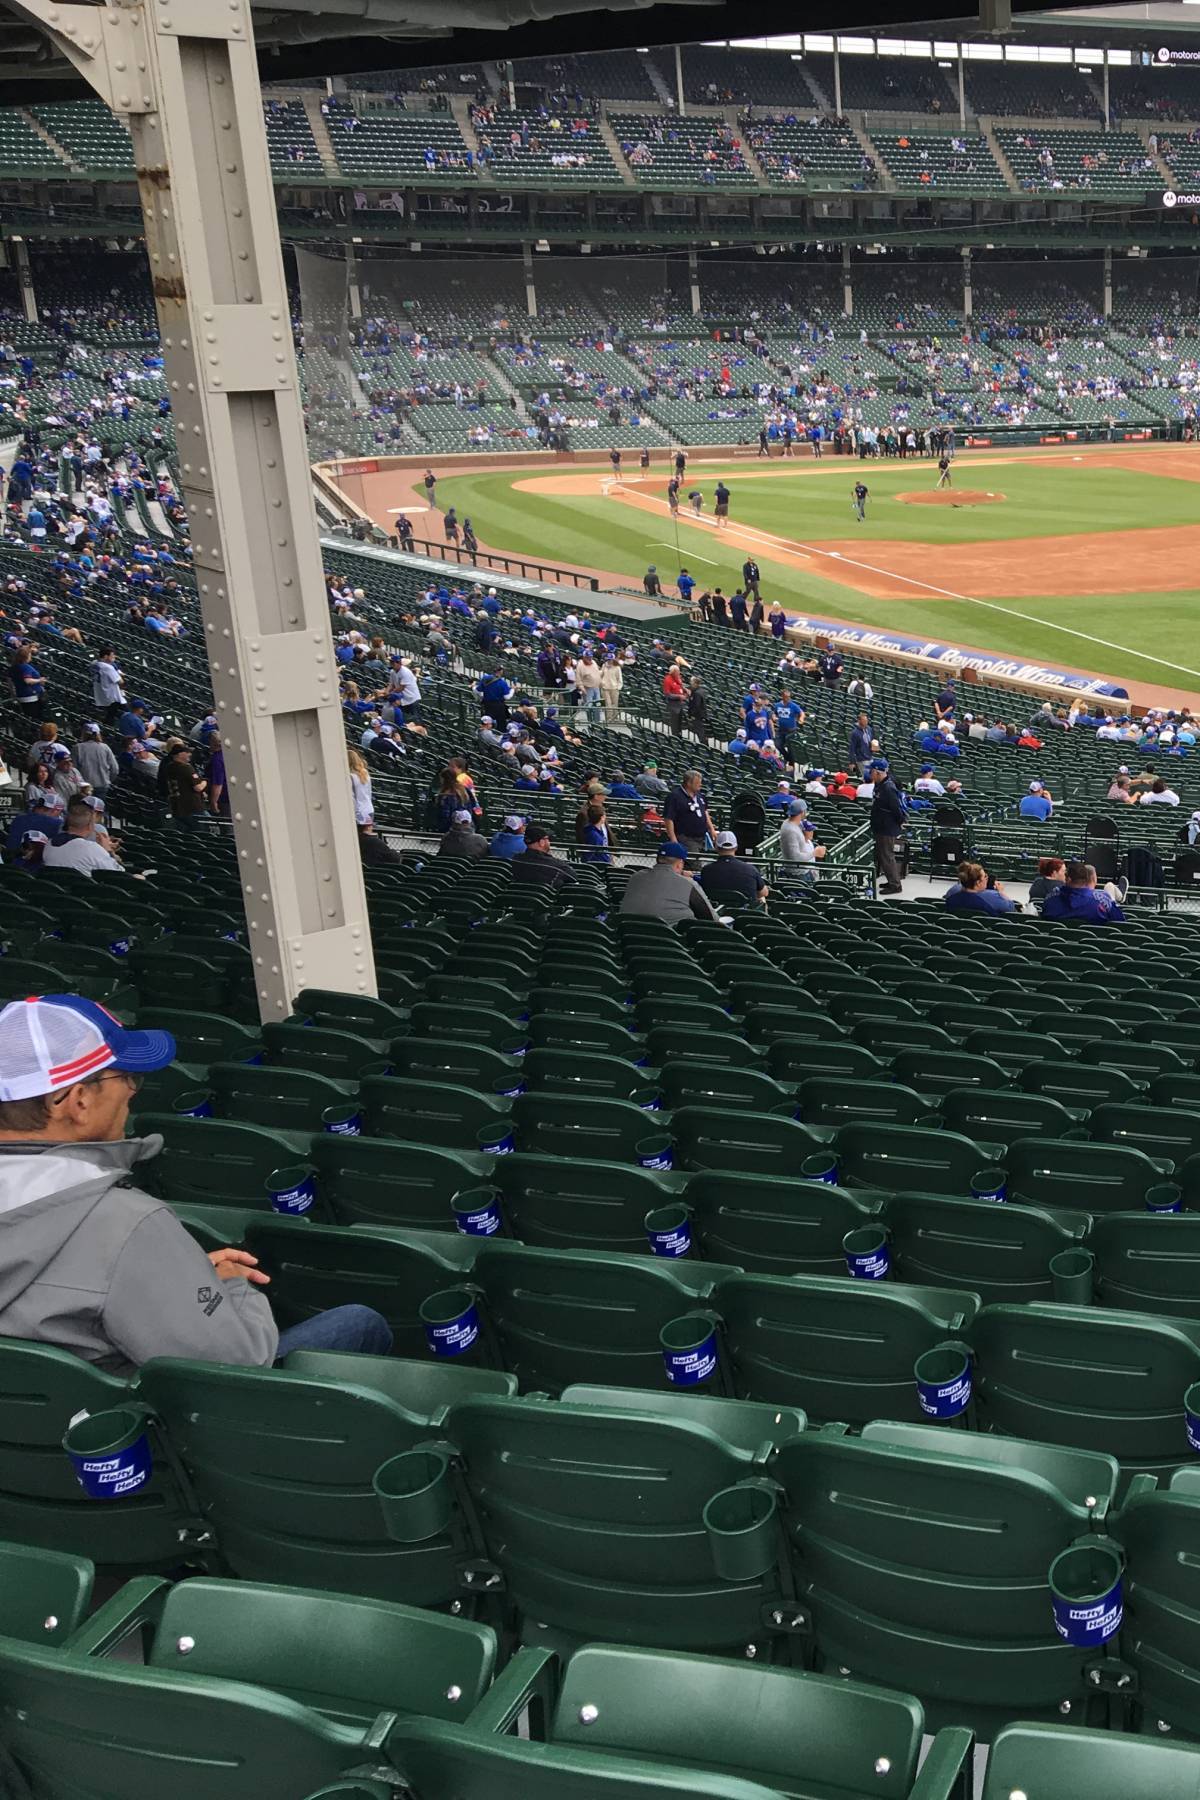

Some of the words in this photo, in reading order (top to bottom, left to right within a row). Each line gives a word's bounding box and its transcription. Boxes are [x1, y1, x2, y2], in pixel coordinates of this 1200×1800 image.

[939, 648, 1019, 675] Reynolds
[846, 874, 858, 884] 230
[673, 1356, 697, 1364] Hefty
[939, 1385, 962, 1396] Hefty
[84, 1459, 119, 1471] Hefty
[100, 1468, 133, 1481] Hefty
[116, 1474, 145, 1491] Hefty
[1071, 1608, 1104, 1619] Hefty
[1088, 1611, 1116, 1629] Hefty
